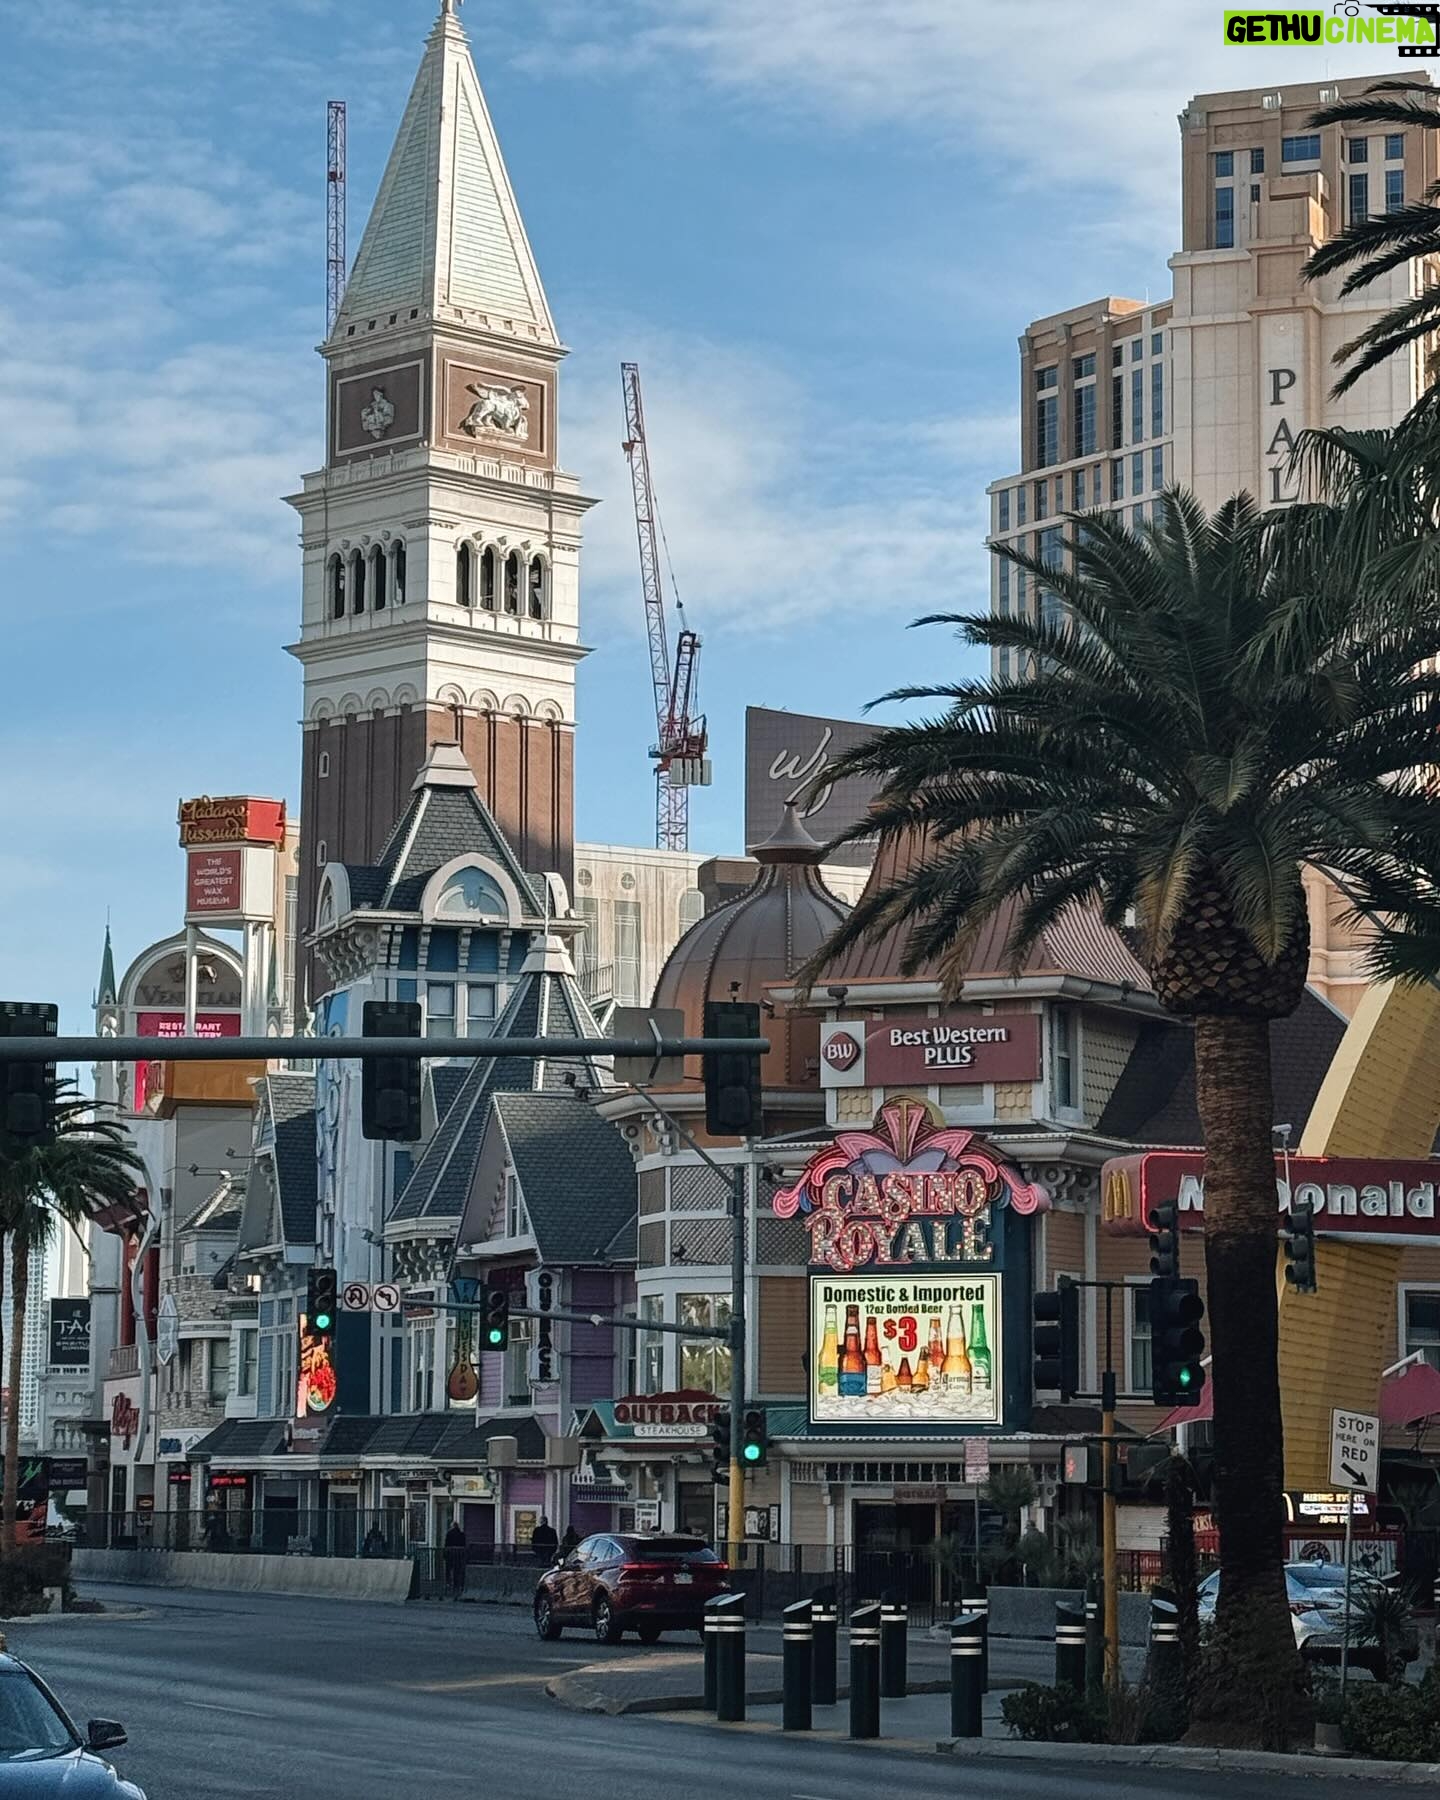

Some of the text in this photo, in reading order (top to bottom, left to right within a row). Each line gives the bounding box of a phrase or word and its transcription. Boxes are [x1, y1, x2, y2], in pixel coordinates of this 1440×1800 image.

[181, 795, 246, 819] Madame
[177, 817, 247, 841] Tussauds
[206, 858, 222, 866] THE
[196, 867, 232, 876] WORLD'S
[193, 877, 234, 886] GREATEST
[203, 888, 223, 896] WAX
[196, 897, 230, 905] MUSEUM
[890, 1027, 1007, 1046] Best Western
[827, 1043, 853, 1060] BW
[924, 1046, 972, 1064] PLUS
[822, 1170, 987, 1221] CASINO
[804, 1206, 993, 1271] ROYALE
[823, 1284, 984, 1303] Domestic & Imported
[865, 1304, 943, 1314] 12oz Bottled Beer
[883, 1316, 917, 1352] $3
[614, 1404, 720, 1424] OUTBACK
[640, 1426, 702, 1436] STEAKHOUSE
[1338, 1416, 1374, 1433] STOP
[1335, 1432, 1376, 1447] HERE ON
[1341, 1446, 1369, 1462] RED
